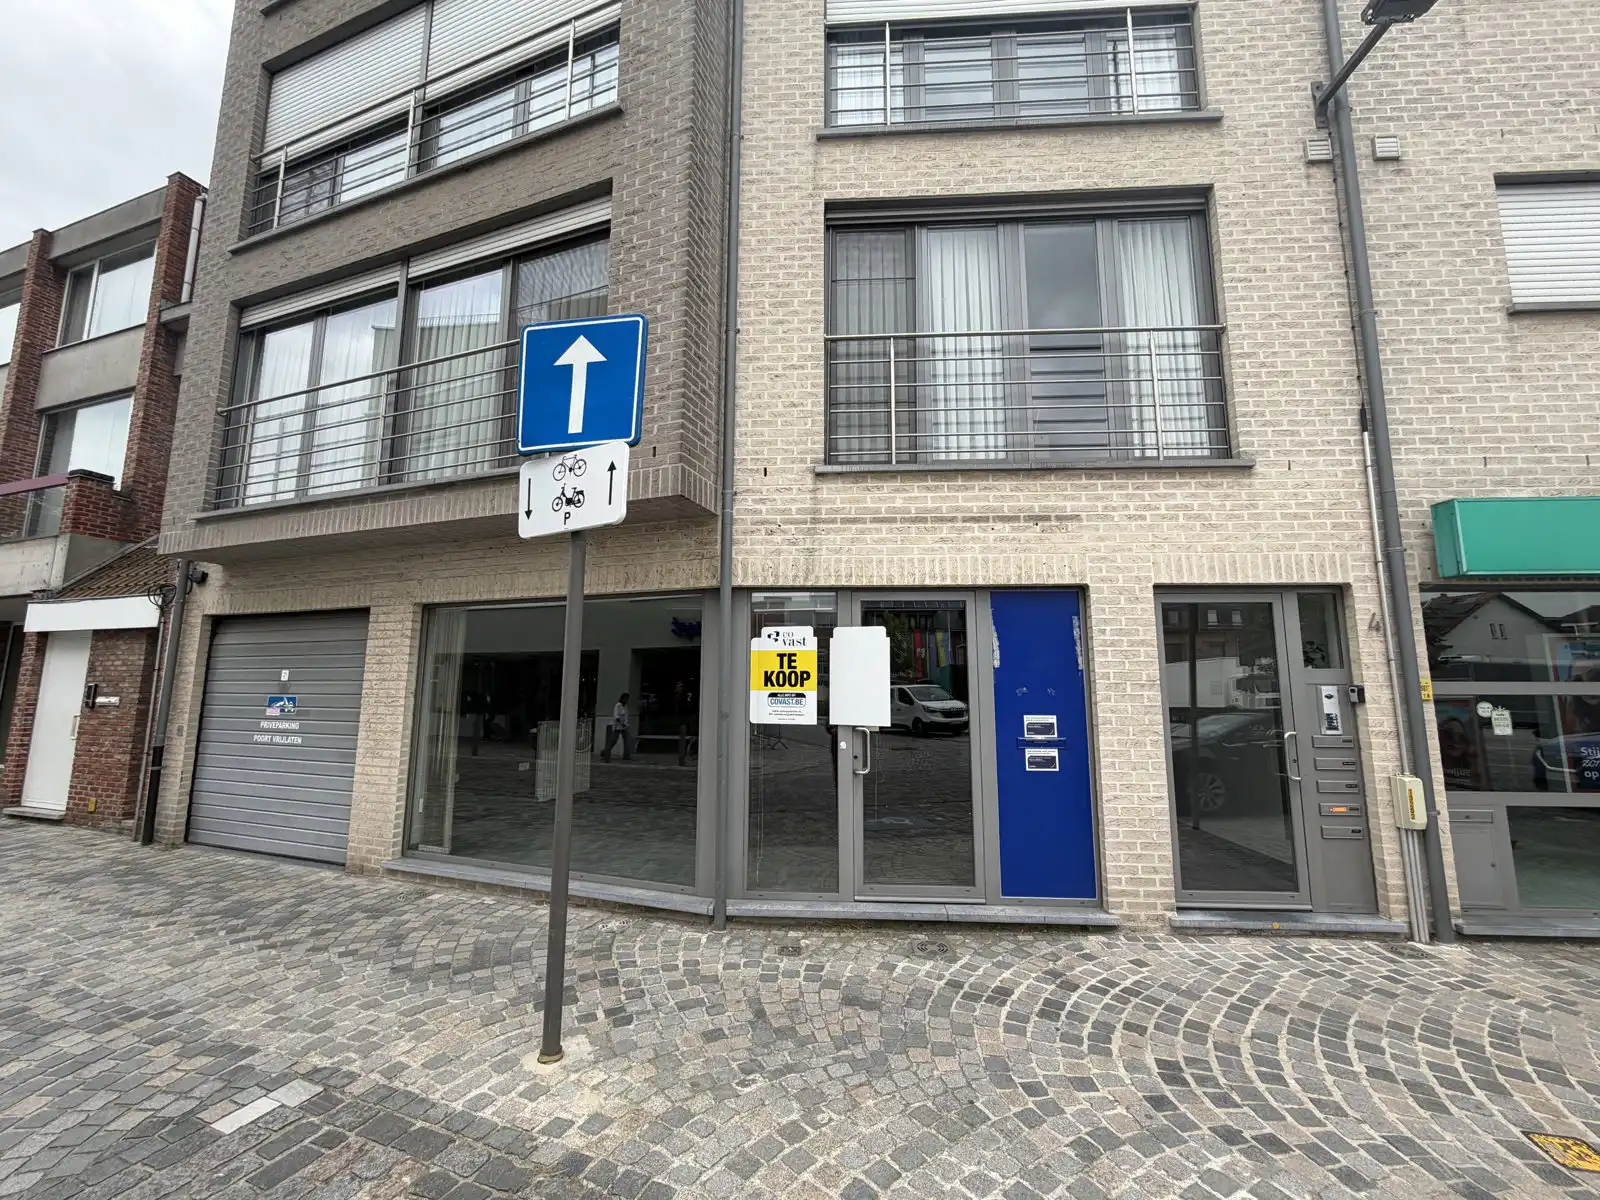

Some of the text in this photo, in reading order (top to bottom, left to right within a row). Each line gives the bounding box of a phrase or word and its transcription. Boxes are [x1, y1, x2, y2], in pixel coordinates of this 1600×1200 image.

[564, 512, 571, 525] P
[782, 636, 807, 647] vast
[777, 653, 797, 669] TE
[764, 671, 811, 687] KOOP
[770, 698, 803, 706] COVAST.BE
[260, 721, 299, 729] PRIVEPARKING
[253, 734, 302, 744] POORT VRIJLATEN
[1584, 770, 1600, 780] op
